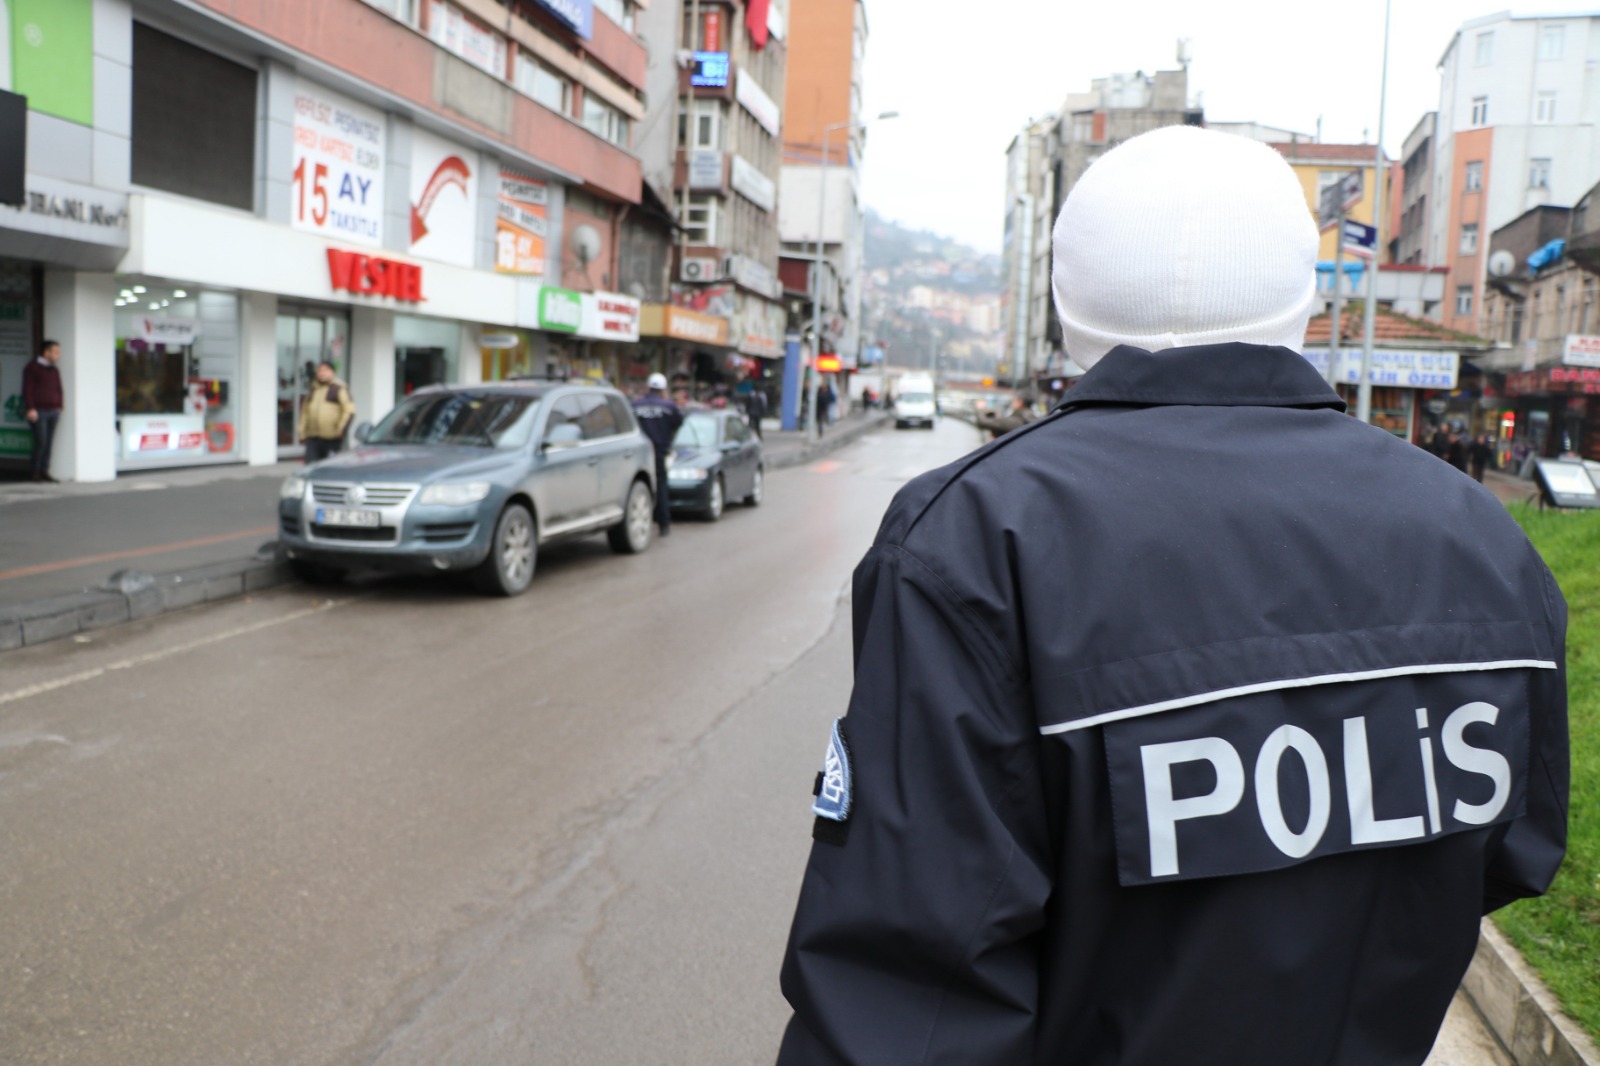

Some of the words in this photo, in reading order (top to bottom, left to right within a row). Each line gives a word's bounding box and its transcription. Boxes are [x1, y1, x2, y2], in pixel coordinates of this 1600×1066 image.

[292, 156, 329, 227] 15
[338, 171, 372, 205] AY
[1408, 370, 1453, 387] ÖZER
